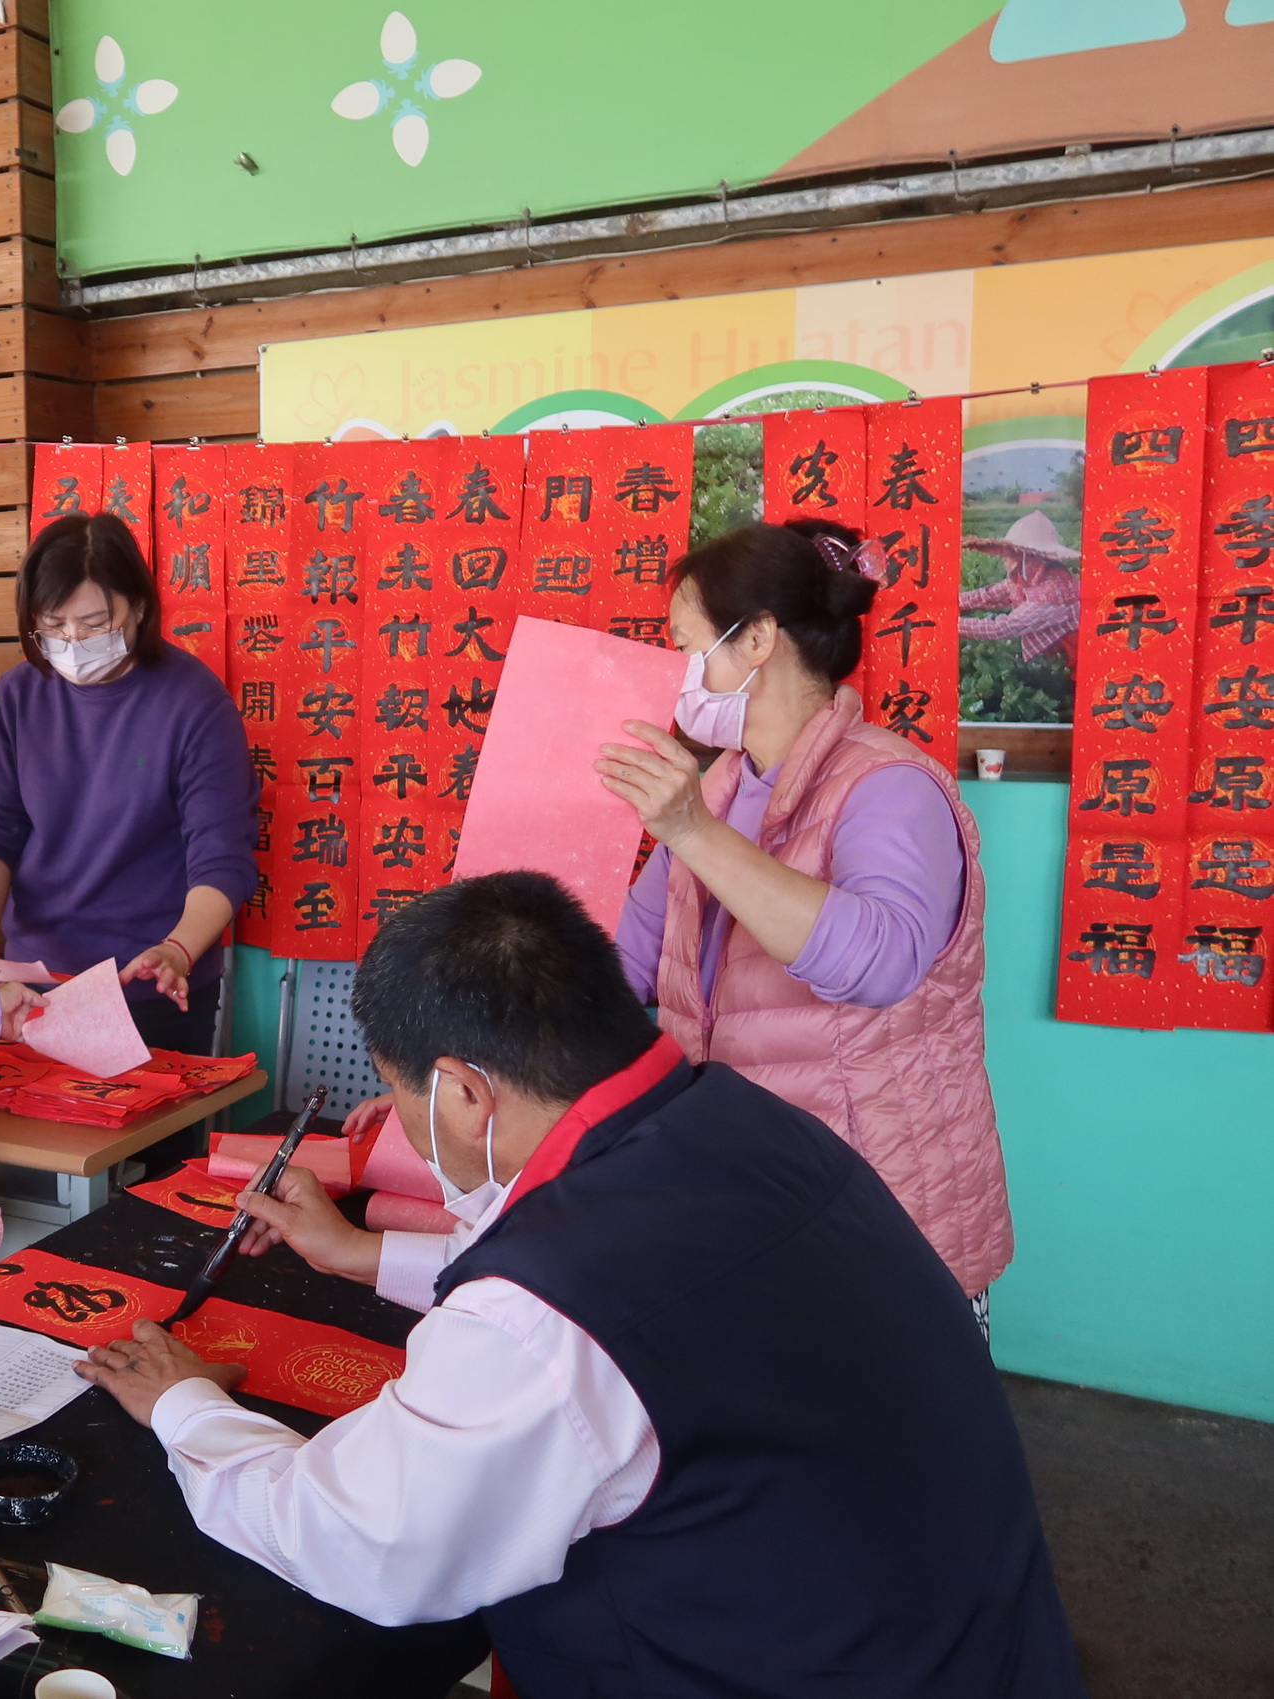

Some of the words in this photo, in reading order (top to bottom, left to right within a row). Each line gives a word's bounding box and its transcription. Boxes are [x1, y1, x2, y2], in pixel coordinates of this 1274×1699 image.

[396, 345, 659, 421] Jasmine
[688, 318, 968, 388] Huatan
[291, 479, 365, 931] 竹報平安百瑞至
[1066, 425, 1185, 980] 四季平安原是福
